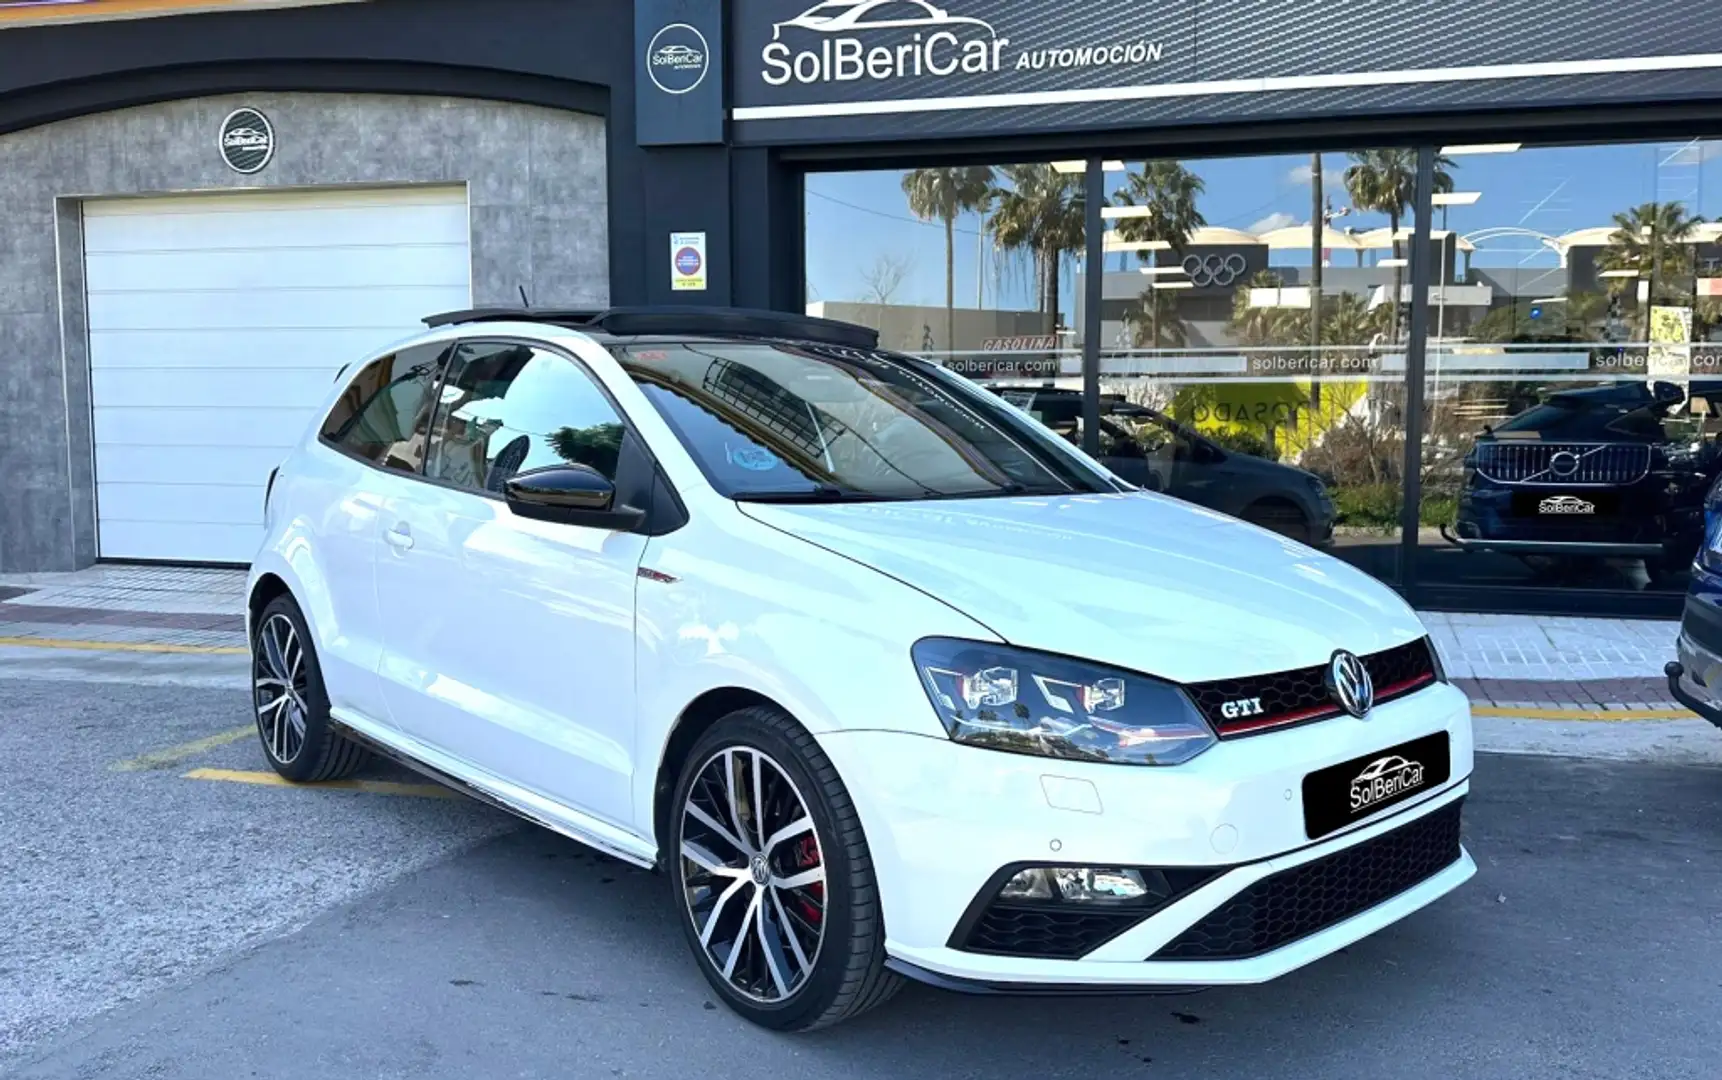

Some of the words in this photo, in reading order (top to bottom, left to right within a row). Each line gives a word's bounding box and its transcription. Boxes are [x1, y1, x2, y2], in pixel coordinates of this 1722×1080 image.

[762, 32, 1009, 85] SolBeriCar
[1015, 40, 1163, 70] AUTOMOCIÓN
[983, 336, 1055, 351] GASOLINA
[946, 358, 1056, 372] solbericar.com
[1221, 698, 1264, 718] GTI
